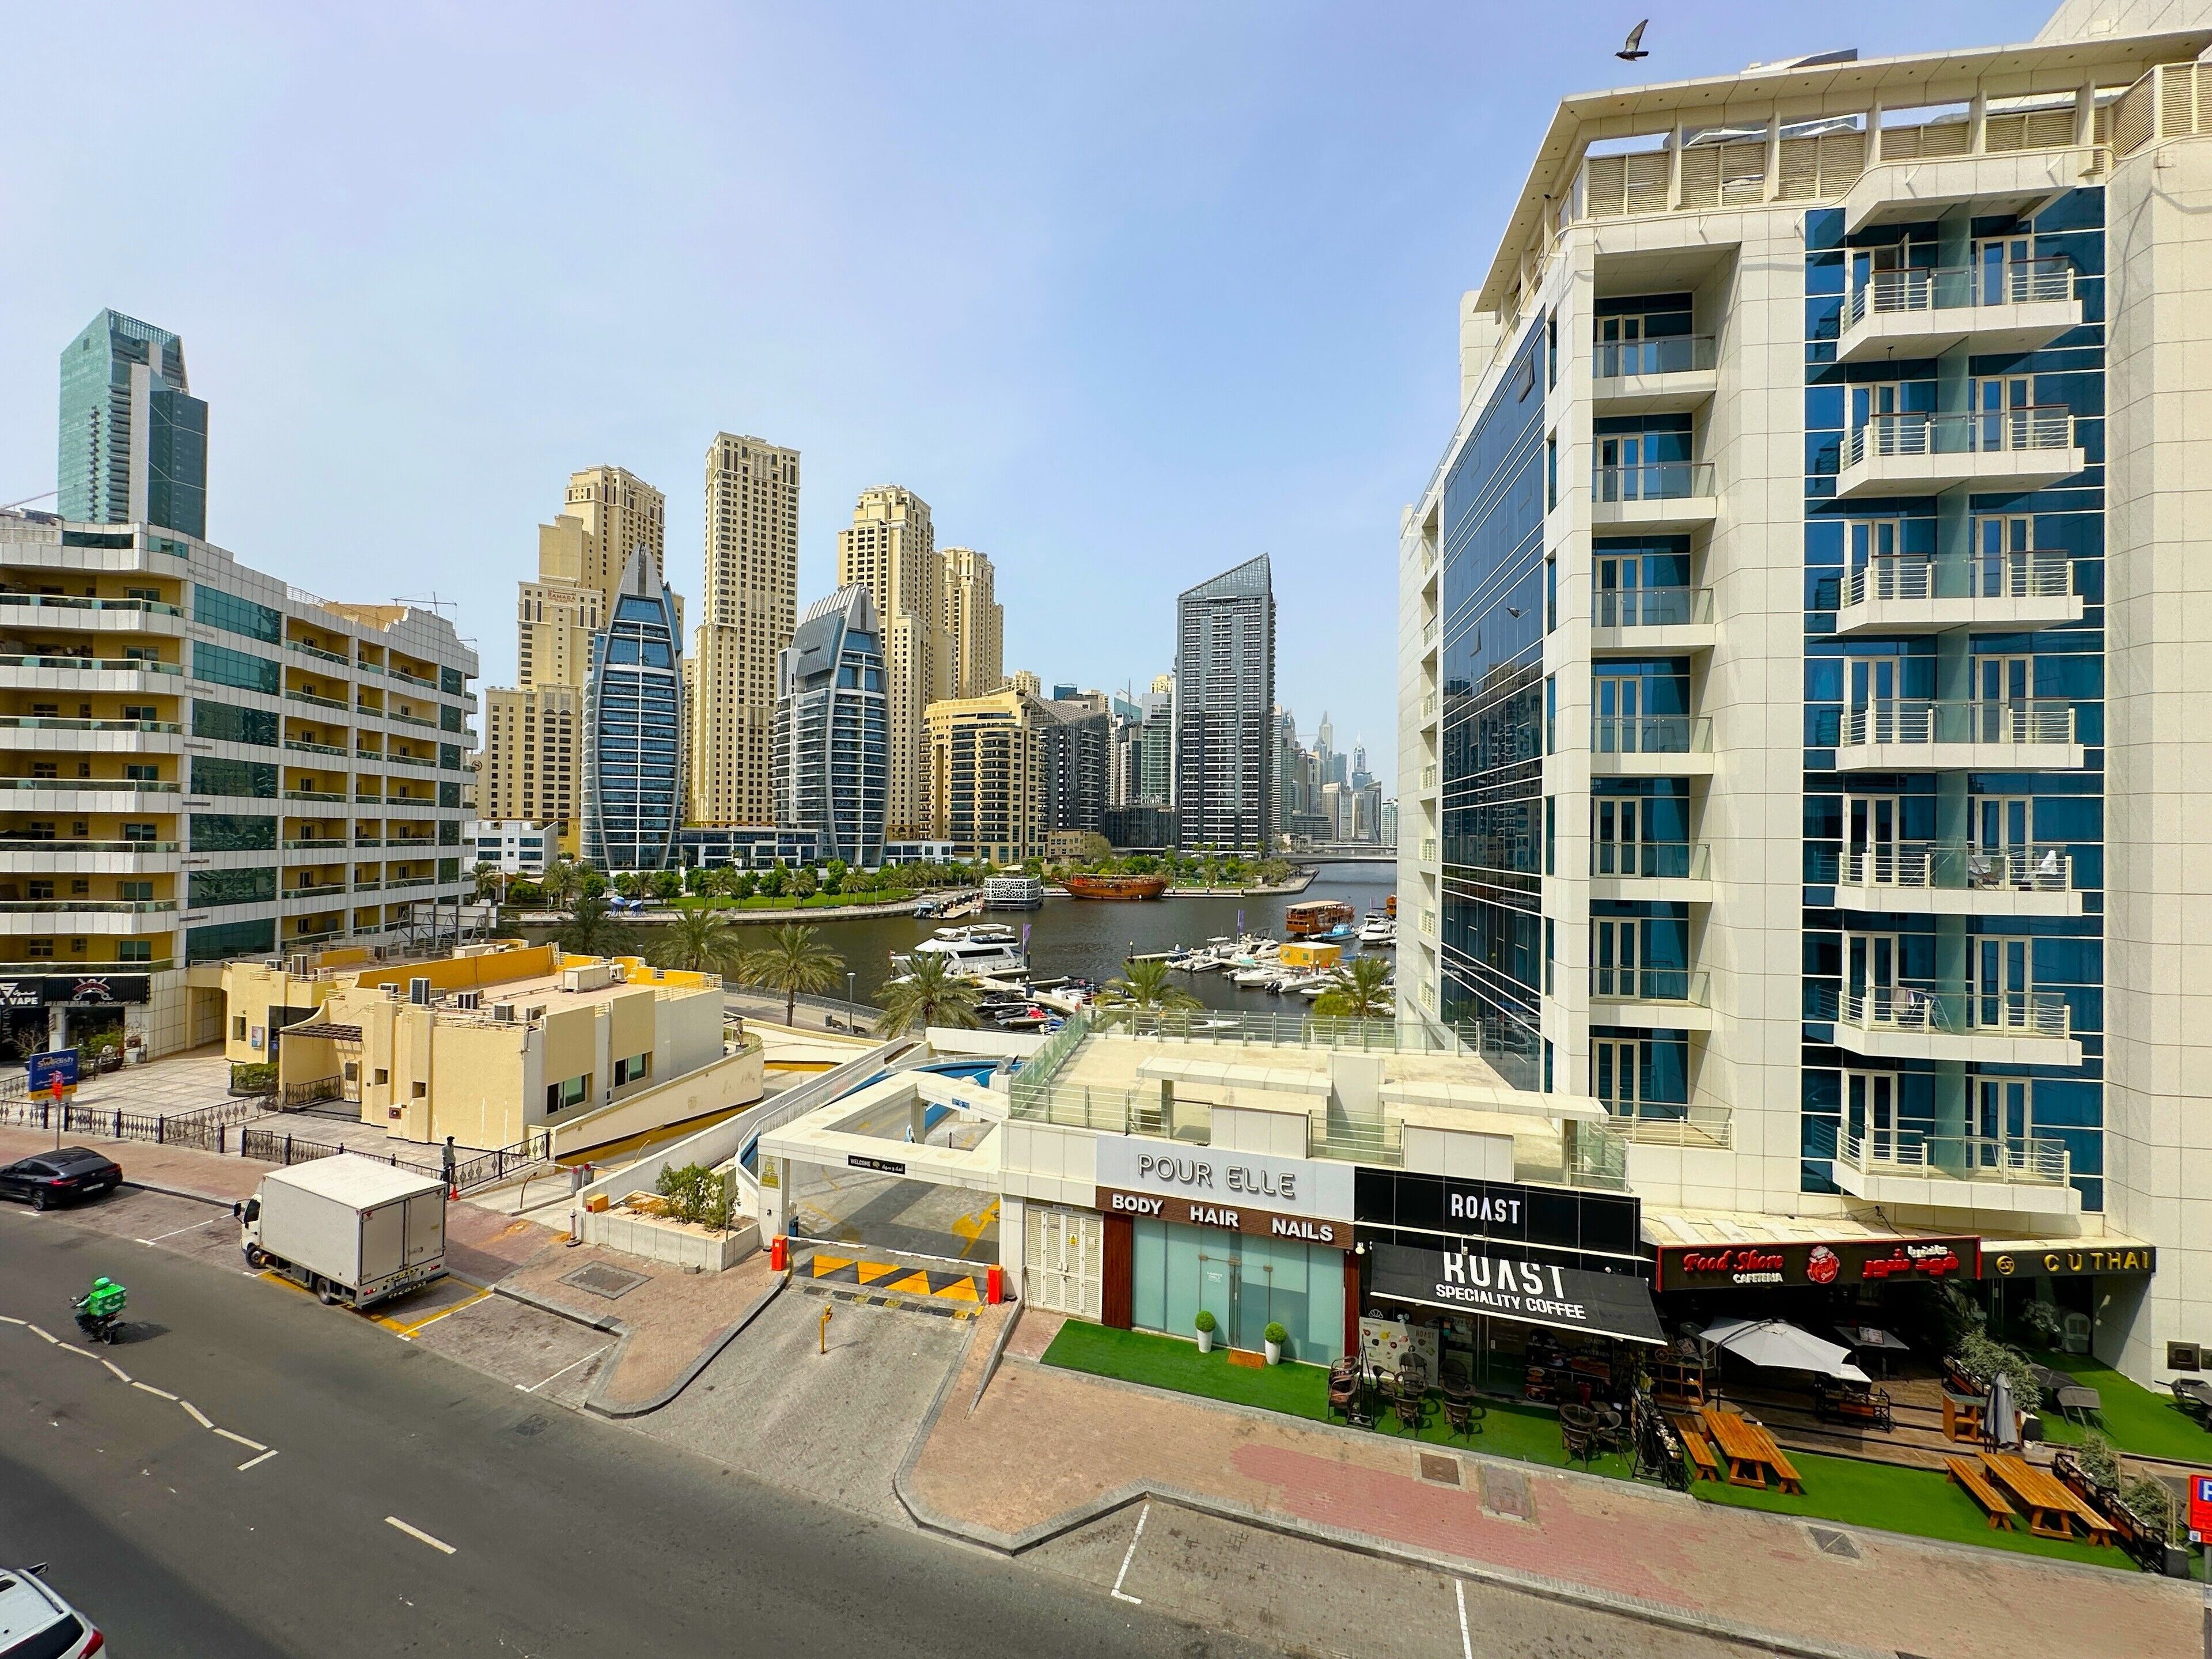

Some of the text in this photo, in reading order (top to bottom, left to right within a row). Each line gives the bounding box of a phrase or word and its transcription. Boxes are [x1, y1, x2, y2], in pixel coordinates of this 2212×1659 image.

[9, 997, 39, 1005] VAPE
[1138, 1153, 1296, 1198] POUR ELLE
[1112, 1194, 1334, 1242] BODY HAIR NAILS
[1450, 1193, 1521, 1225] ROAST
[1683, 1249, 1784, 1272] Food Shore
[2089, 1251, 2149, 1271] THAI
[1443, 1251, 1565, 1300] ROAST
[1732, 1272, 1783, 1284] CAFETERIA
[1435, 1283, 1586, 1320] SPECIALITY COFFEE
[1415, 1330, 1435, 1339] ROAST
